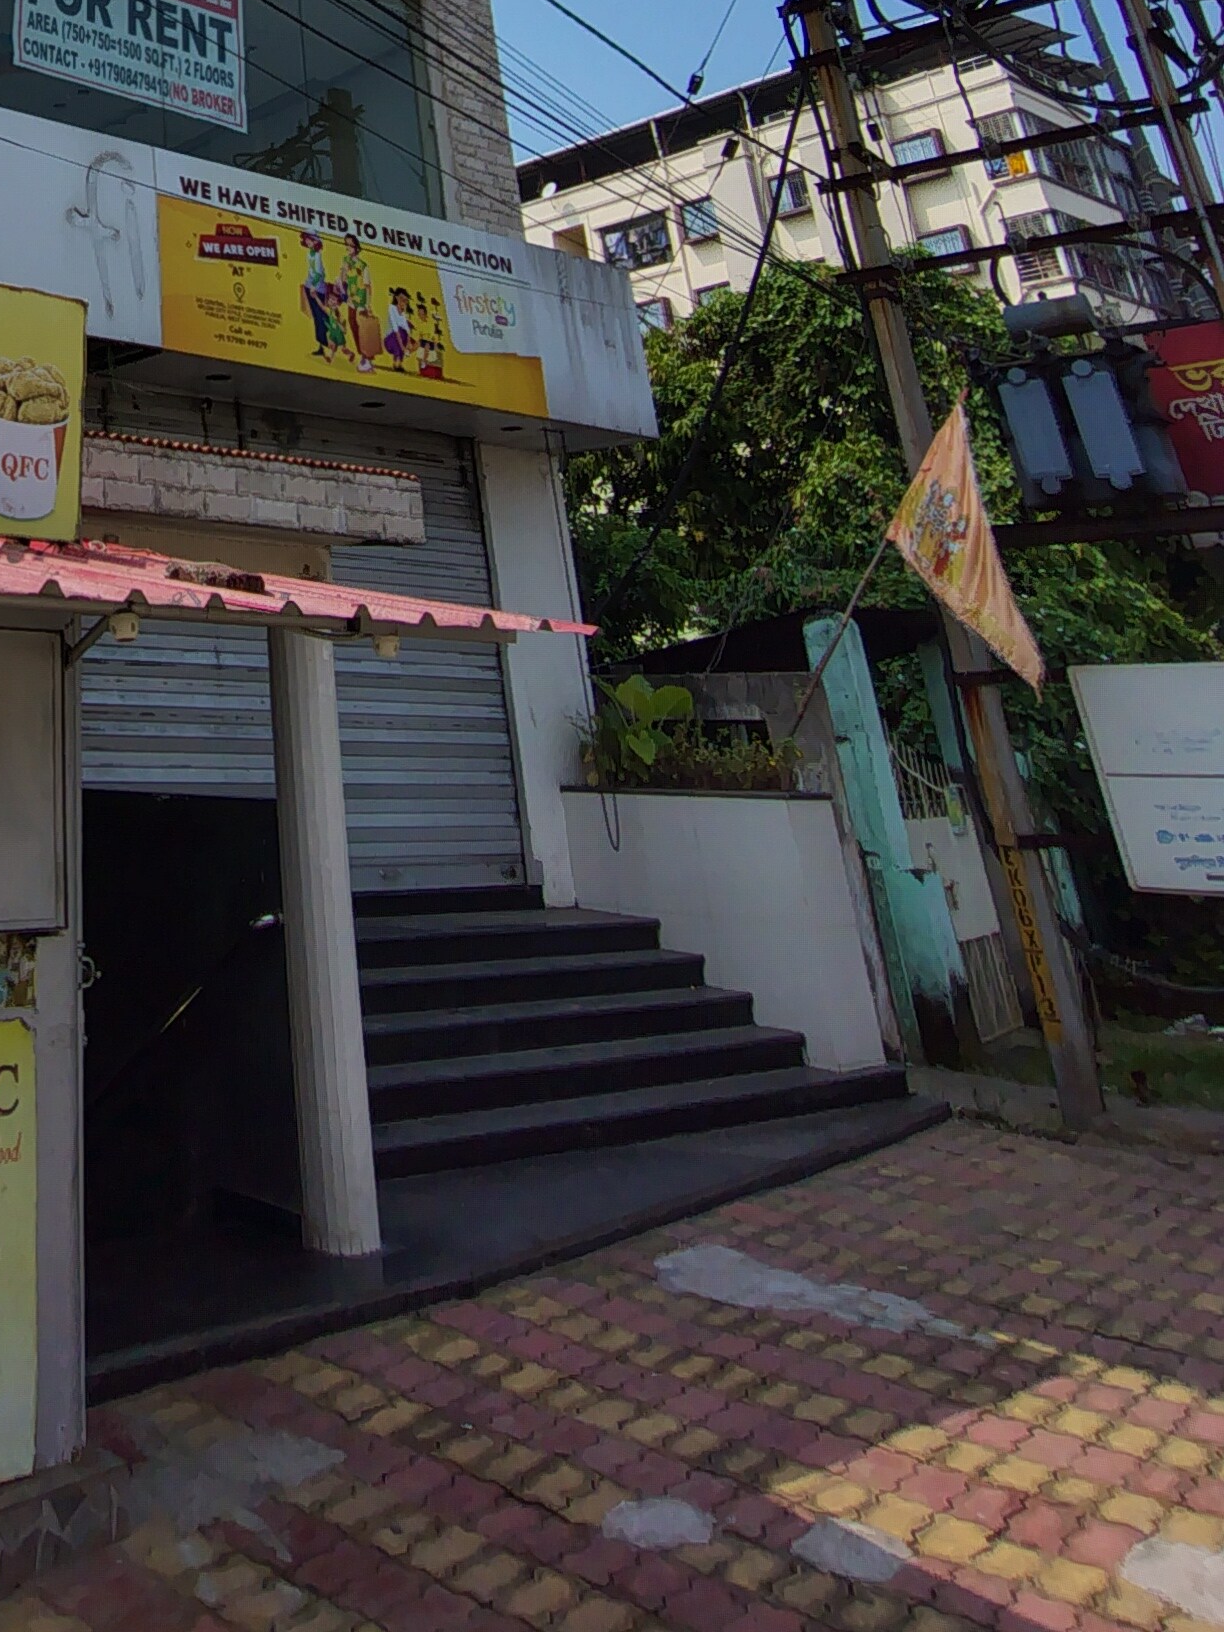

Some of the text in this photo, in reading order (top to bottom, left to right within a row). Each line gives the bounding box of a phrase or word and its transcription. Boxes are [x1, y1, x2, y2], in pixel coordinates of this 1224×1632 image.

[23, 38, 78, 69] CONTACT
[26, 10, 59, 36] AREA
[184, 58, 191, 76] 2
[193, 62, 235, 89] FLOORS
[179, 176, 512, 274] WE HAVE SHIFTED TO NEW LOCATION
[202, 242, 276, 258] WE ARE OPEN
[232, 266, 244, 277] AT
[1, 453, 49, 481] QFC
